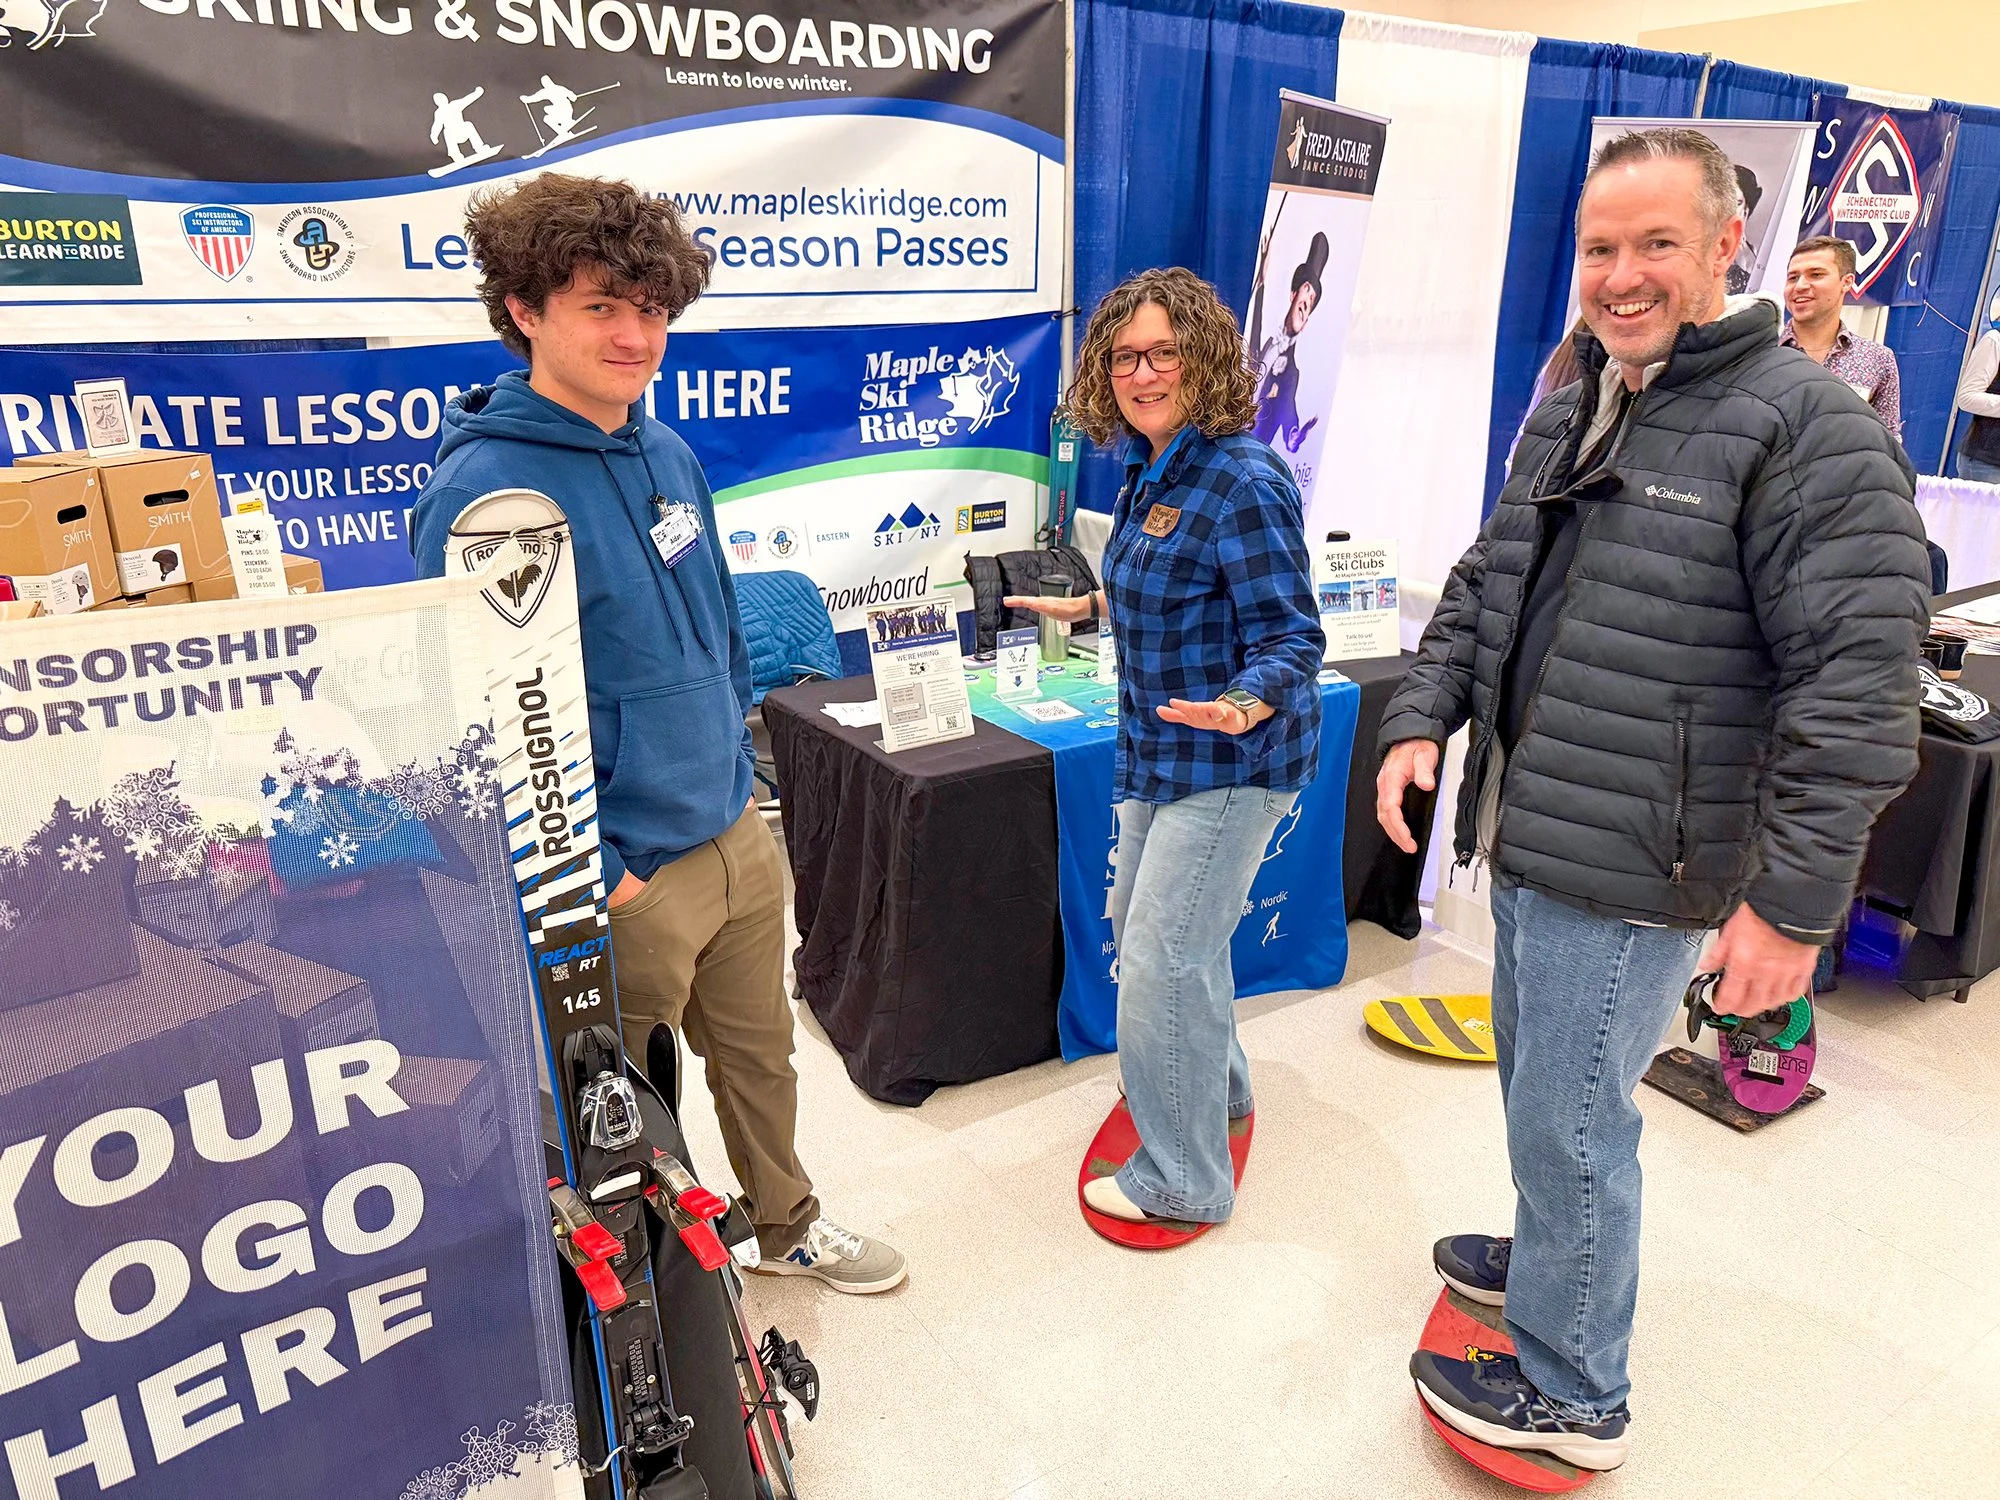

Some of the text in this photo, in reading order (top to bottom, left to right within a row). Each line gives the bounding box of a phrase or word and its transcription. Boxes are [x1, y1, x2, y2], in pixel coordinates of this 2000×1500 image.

[434, 0, 481, 43] &
[496, 0, 994, 75] SNOWBOARDING
[666, 66, 853, 93] Learn to love winter.
[1305, 131, 1372, 166] FRED ASTAIRE
[1302, 159, 1368, 180] DANCE STUDIOS
[194, 211, 239, 219] PROFESSIONAL
[643, 187, 1007, 223] ww.mapleskiridge.com
[1836, 207, 1911, 220] WINTERSPORTS CLUB
[1846, 195, 1899, 207] SCHENECTADY
[0, 218, 122, 242] BURTON
[202, 218, 244, 227] INSTRUCTORS
[210, 226, 237, 234] AMERICA
[276, 206, 355, 240] AMERICAN ASSOCIATION OF
[79, 244, 125, 260] RIDE
[401, 223, 1009, 271] Le Season Passes
[279, 249, 356, 282] SNOWBOARD INSTRUCTORS
[862, 346, 955, 386] Maple
[859, 379, 910, 411] Ski
[0, 393, 245, 455] RIATE
[263, 383, 481, 446] LESSO
[677, 367, 792, 420] HERE
[858, 411, 958, 448] Ridge
[243, 467, 337, 502] YOUR
[1655, 486, 1702, 505] Columbia
[148, 511, 192, 528] SMITH
[316, 510, 398, 547] HAVE
[974, 509, 1004, 519] BURTON
[63, 529, 93, 547] SMITH
[816, 532, 850, 543] EASTERN
[874, 525, 941, 547] SKI NY
[1330, 558, 1385, 572] Ski Clubs
[817, 566, 929, 613] nowboard
[0, 623, 318, 694] NSORSHIP
[917, 649, 940, 659] HIRING
[0, 666, 324, 742] ORTUNITY
[516, 667, 573, 858] ROSSIGNOL
[1260, 889, 1289, 909] Nordic
[538, 935, 609, 969] REACT
[578, 955, 602, 972] RT
[562, 987, 601, 1014] 145
[0, 1039, 411, 1247] YOUR
[0, 1162, 425, 1396] LOGO
[3, 1267, 434, 1500] HERE
